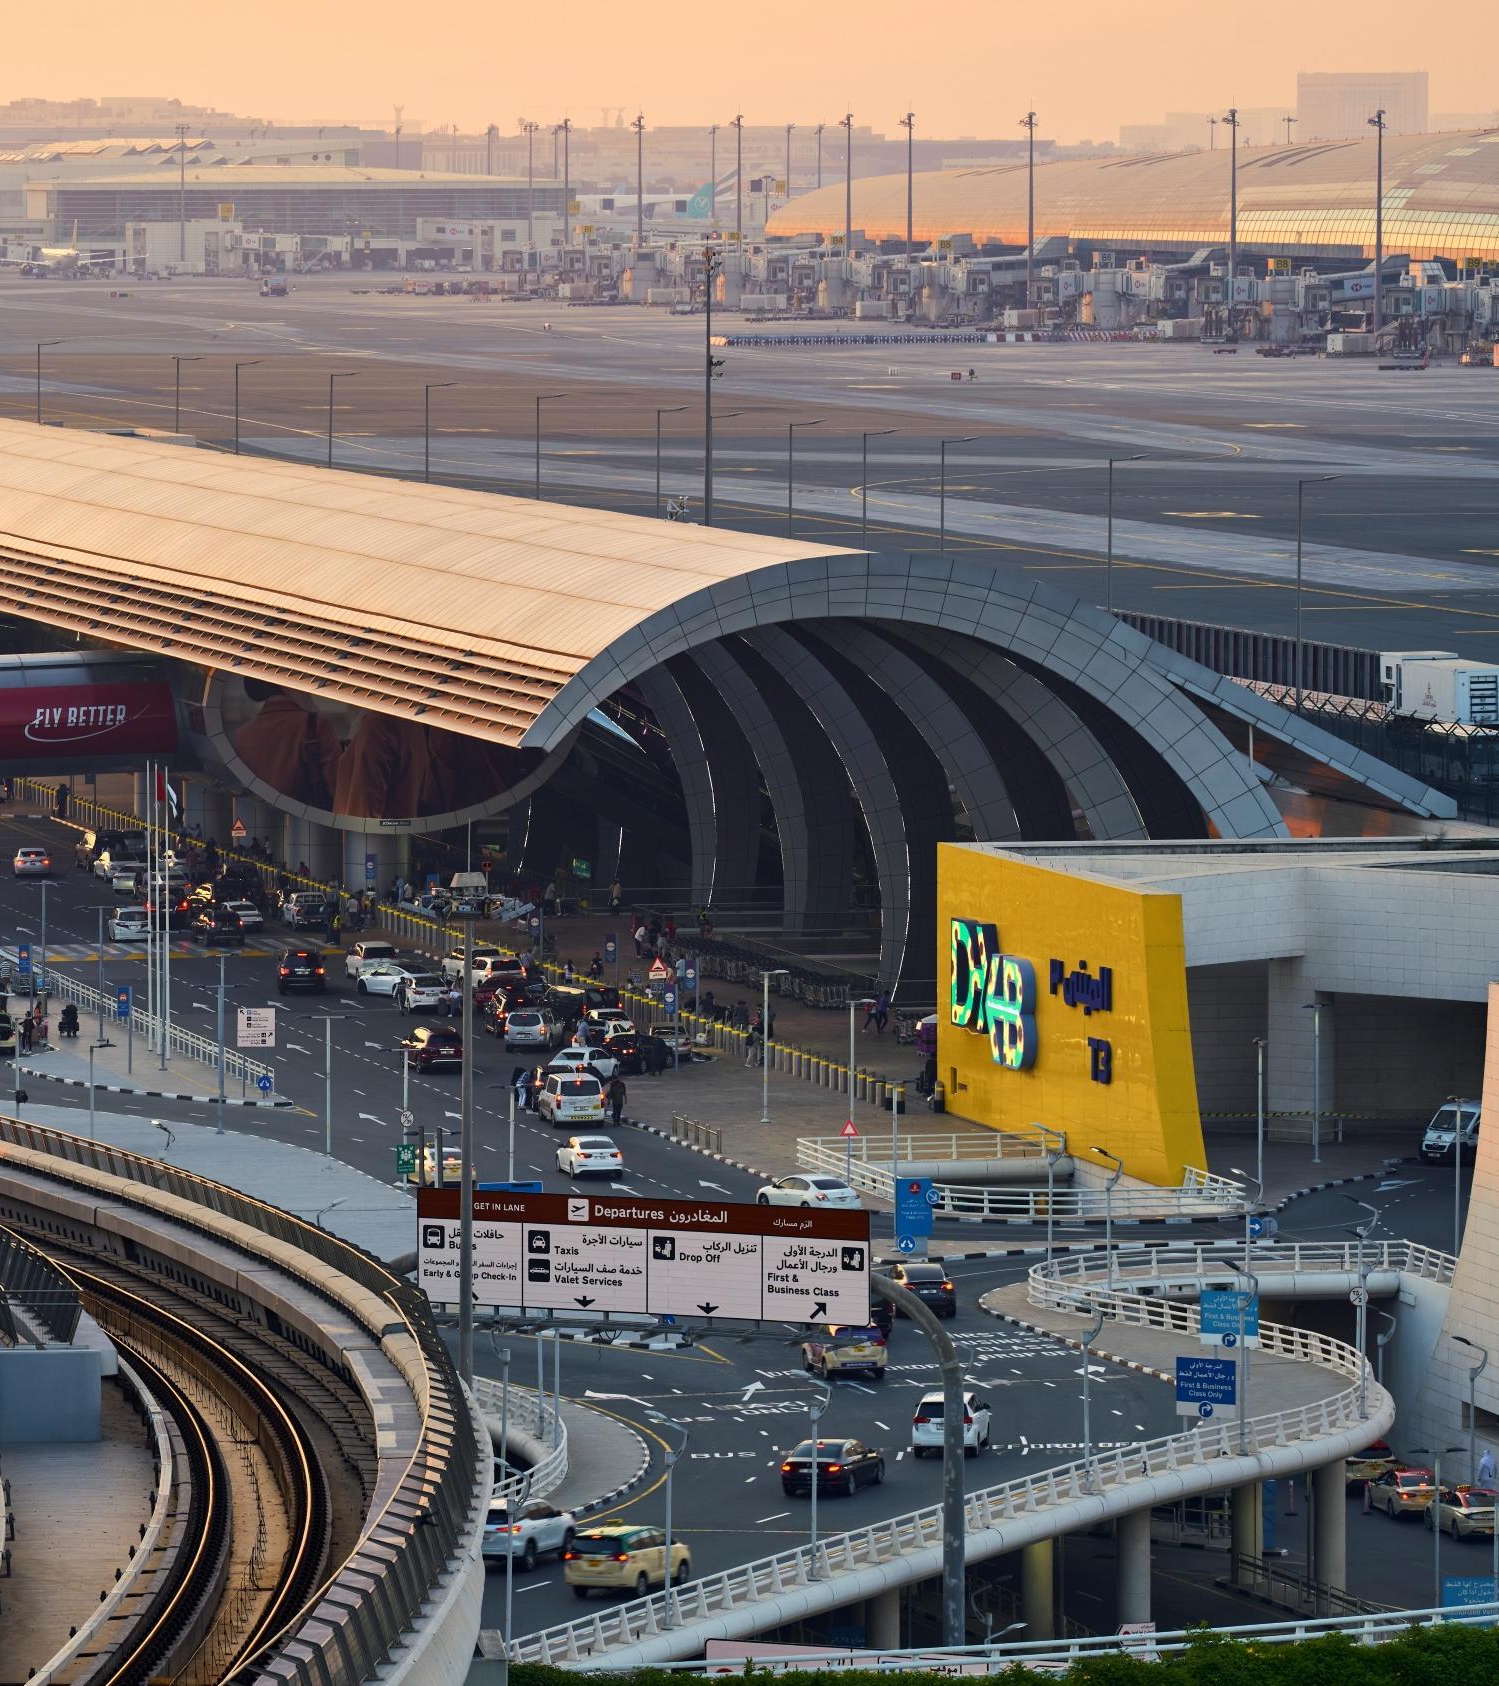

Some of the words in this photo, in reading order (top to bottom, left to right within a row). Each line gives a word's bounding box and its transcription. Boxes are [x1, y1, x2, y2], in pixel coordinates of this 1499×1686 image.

[34, 708, 62, 728] FLY
[67, 705, 126, 726] BETTER
[473, 1202, 490, 1210] GET
[503, 1204, 525, 1212] LANE
[595, 1205, 664, 1219] Departures
[669, 1210, 727, 1223] المغادرون
[449, 1241, 477, 1250] Bus
[582, 1234, 607, 1246] الأجرة
[609, 1236, 643, 1248] سيارات
[554, 1246, 579, 1255] Taxis
[703, 1241, 731, 1252] الركاب
[734, 1243, 757, 1254] تنزيل
[679, 1252, 702, 1263] Drop
[705, 1254, 720, 1263] Off
[809, 1247, 837, 1258] الدرجة
[554, 1262, 594, 1274] السيارات
[596, 1264, 617, 1273] صف
[619, 1265, 643, 1275] خدمة
[777, 1259, 808, 1270] الأعمال
[811, 1261, 837, 1273] ورجال
[423, 1269, 443, 1278] Early
[481, 1272, 517, 1281] Check-In
[767, 1273, 789, 1282] First
[792, 1274, 799, 1282] &
[554, 1275, 579, 1284] Valet
[582, 1276, 623, 1286] Services
[767, 1285, 810, 1295] Business
[813, 1287, 839, 1297] Class
[1181, 1381, 1195, 1389] First
[1202, 1383, 1232, 1391] Business
[1207, 1391, 1222, 1399] Only
[741, 1406, 810, 1415] ONLY
[691, 1451, 757, 1459] BUS
